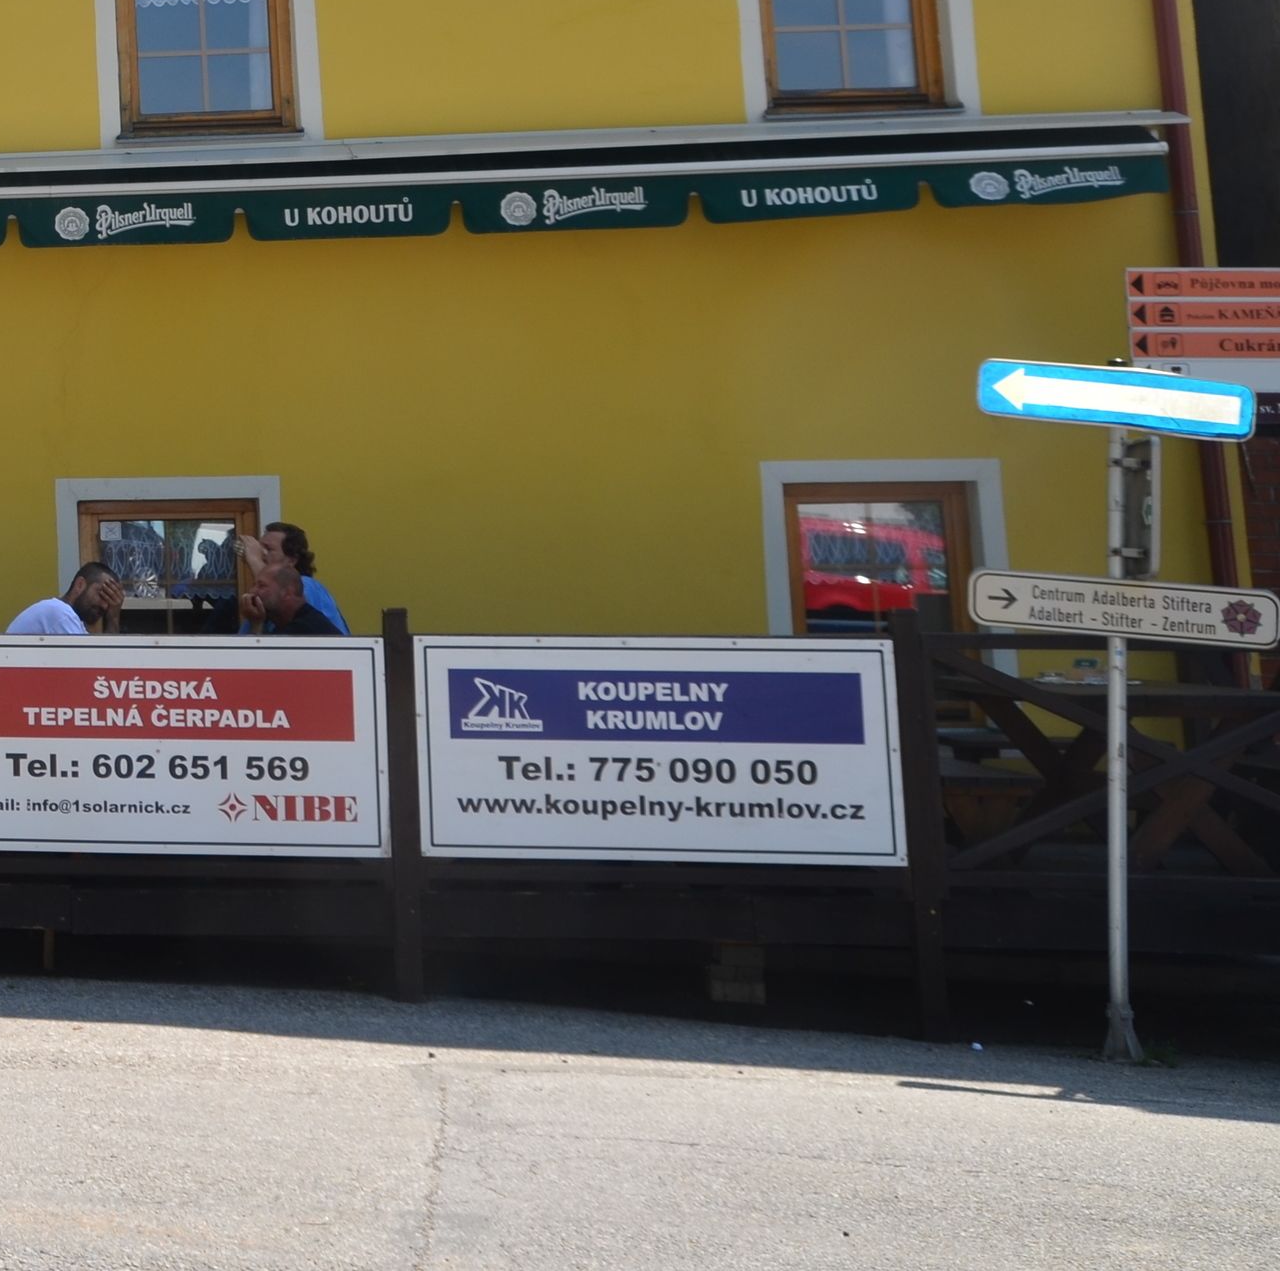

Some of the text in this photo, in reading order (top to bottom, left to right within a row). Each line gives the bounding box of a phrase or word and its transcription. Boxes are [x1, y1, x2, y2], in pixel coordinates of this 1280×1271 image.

[740, 178, 878, 208] U KOHOUTŮ
[1013, 166, 1121, 199] Pilsner Urquell
[95, 202, 192, 239] Pilsner Urquell
[284, 197, 413, 227] U KOHOUTŮ
[542, 186, 644, 225] Pilsner Urquell
[1032, 584, 1212, 614] Centrum Adalberta Stiftera
[1028, 605, 1084, 624] Adalbert
[1101, 611, 1144, 629] Stifter
[1162, 616, 1217, 636] Zentrum
[92, 676, 218, 701] ŠVÉDSKÁ
[576, 681, 730, 703] KOUPELNY
[22, 703, 291, 729] TEPELNÁ ČERPADLA
[585, 709, 724, 732] KRUMLOV
[5, 751, 310, 782] Tel.: 602 651 569
[497, 754, 819, 786] Tel.: 775 090 050
[26, 798, 192, 816] info@1solarnick.cz
[251, 794, 359, 823] NIBE
[457, 794, 867, 824] www.koupelny-krumlov.cz
